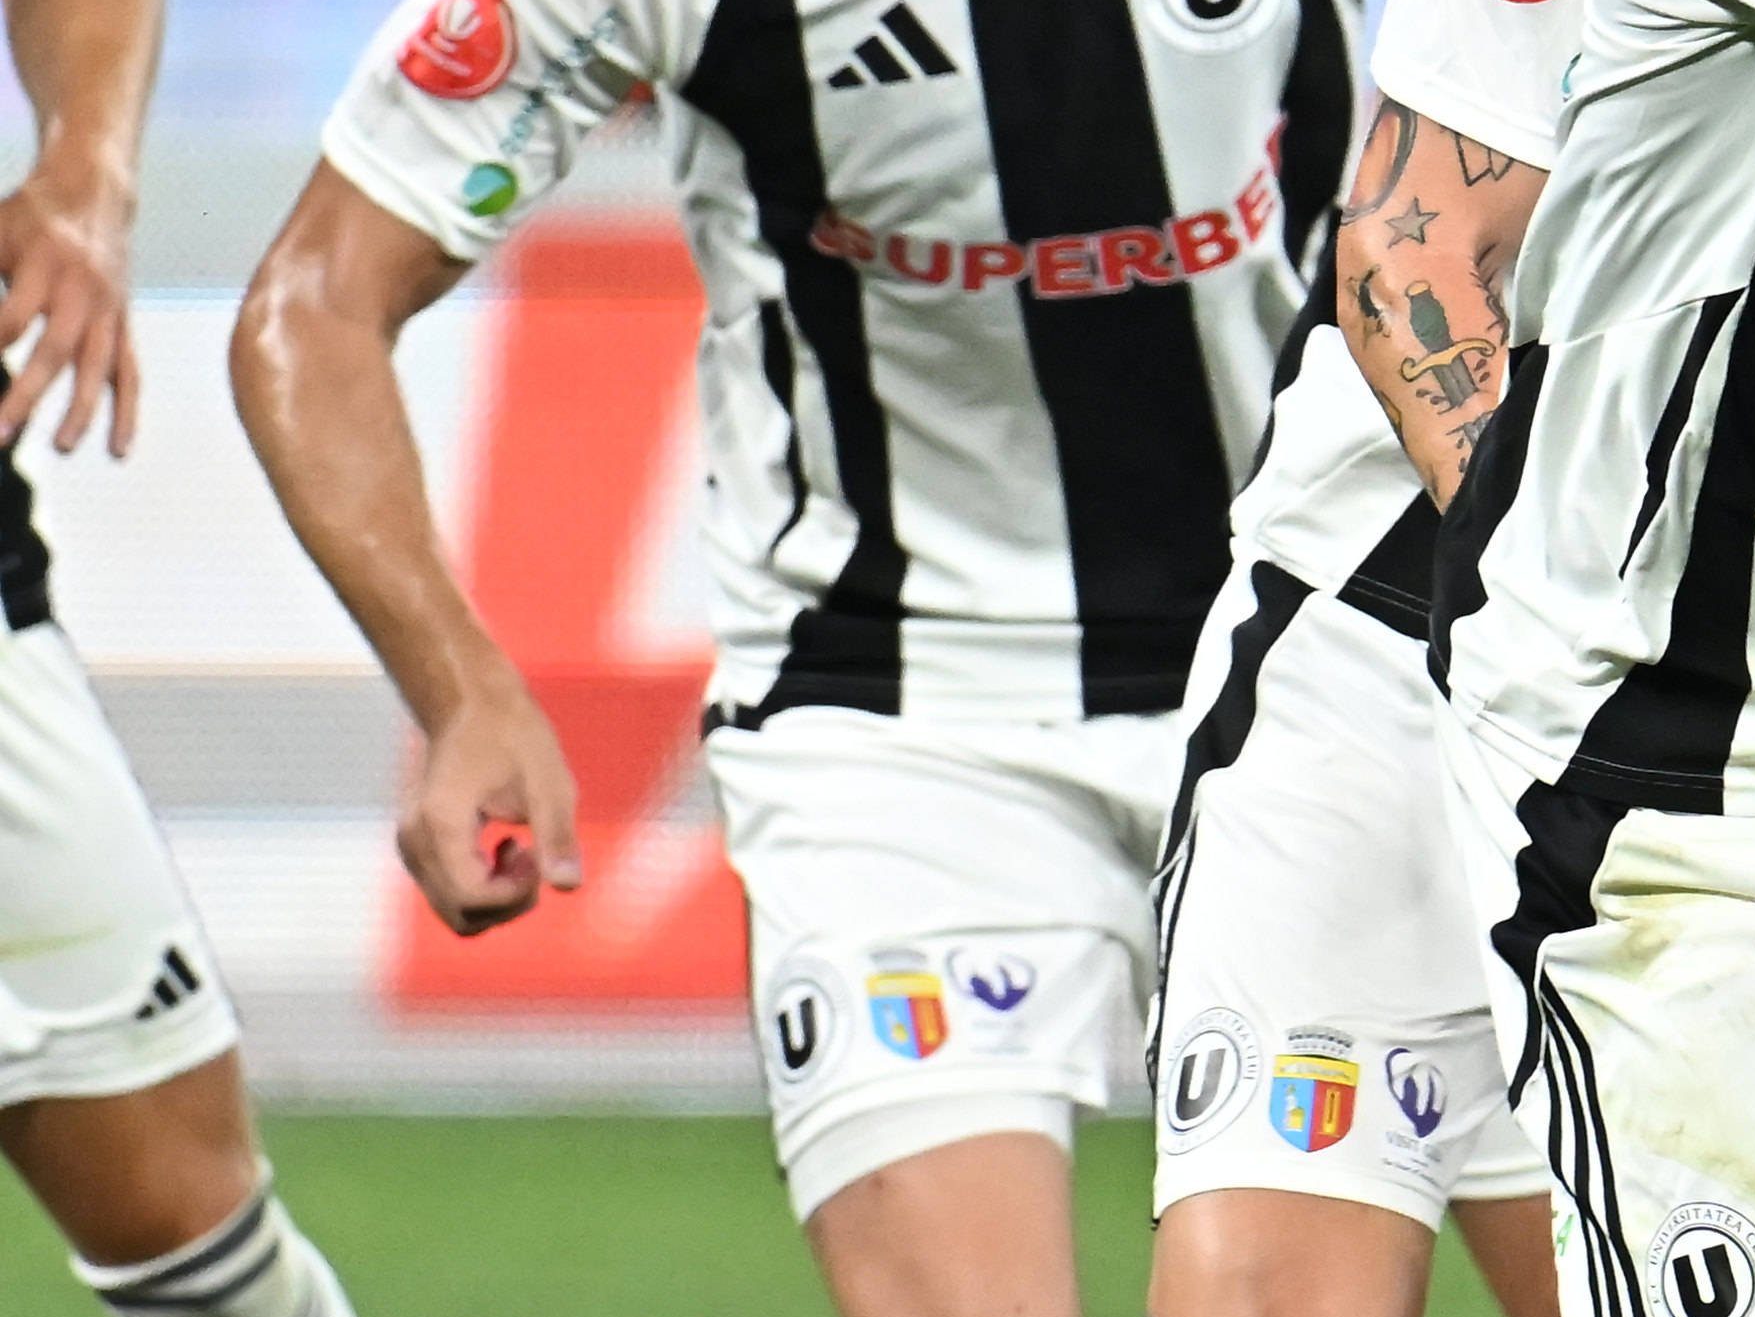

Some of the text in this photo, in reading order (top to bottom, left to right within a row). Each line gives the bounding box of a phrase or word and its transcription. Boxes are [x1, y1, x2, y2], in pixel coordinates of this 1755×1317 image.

[777, 996, 817, 1070] U
[1175, 1047, 1227, 1122] U
[1649, 1206, 1744, 1267] UNIVERSITATEA
